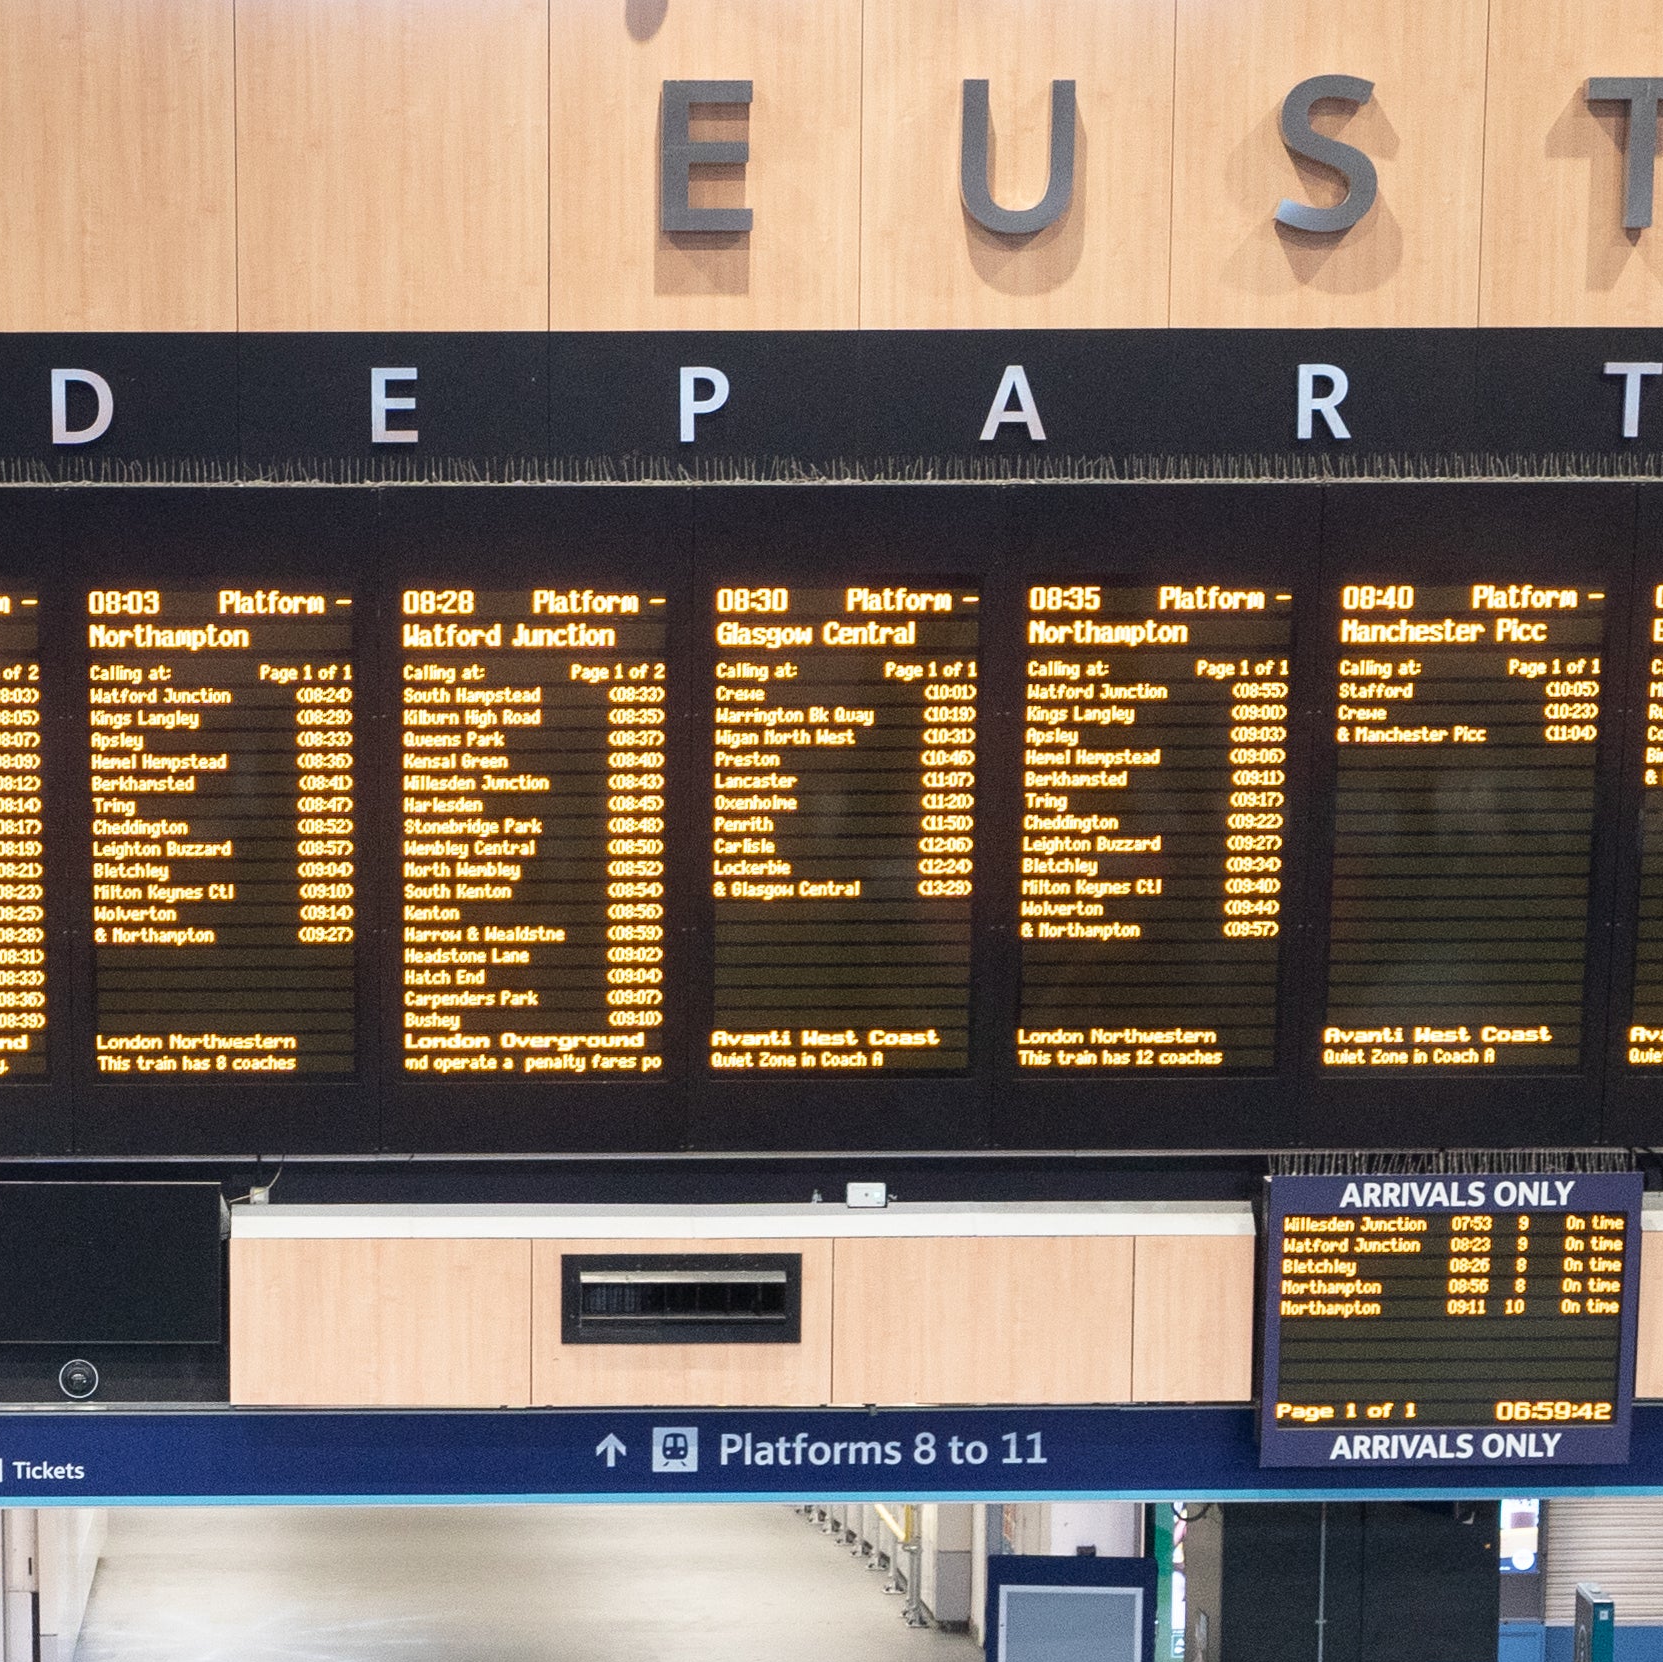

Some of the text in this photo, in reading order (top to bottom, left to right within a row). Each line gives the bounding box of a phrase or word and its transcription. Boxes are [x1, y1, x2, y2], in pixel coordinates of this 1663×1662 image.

[88, 589, 326, 615] 08:03 Platform
[402, 589, 640, 615] 08:28 Platform
[715, 587, 953, 614] 08:30 Platform
[1028, 585, 1266, 612] 08:35 Platform
[1341, 584, 1579, 611] 08:40 Platform
[88, 623, 251, 652] Northampton
[402, 622, 616, 649] Watford Junction
[715, 620, 916, 650] Glasgow Central
[1027, 619, 1189, 648] Northampton
[1340, 617, 1548, 644] Manchester Picc
[1338, 682, 1414, 699] Stafford
[91, 775, 196, 792] Berkhamsted
[713, 772, 798, 790] Lancaster
[404, 989, 539, 1011] Carpenders Park
[710, 1029, 941, 1048] Avanti West Coast
[1017, 1027, 1217, 1045] London Northwestern
[1338, 1180, 1576, 1209] ARRIVALS ONLY
[1283, 1214, 1625, 1233] Willesden Junction 07:53 9 On time
[1283, 1235, 1624, 1254] Watford Junction 08:23 9 On time
[1282, 1256, 1623, 1277] Bletchley 08:26 8 On time
[1281, 1277, 1621, 1298] Northampton 08:56 8 On time
[1280, 1298, 1620, 1318] Northampton 09:11 10 On time
[1275, 1401, 1612, 1422] Page 1 of 1 06:59:42
[720, 1431, 1048, 1466] Platforms 8 to 11
[1329, 1432, 1563, 1460] ARRIVALS ONLY
[11, 1460, 86, 1480] Tickets
